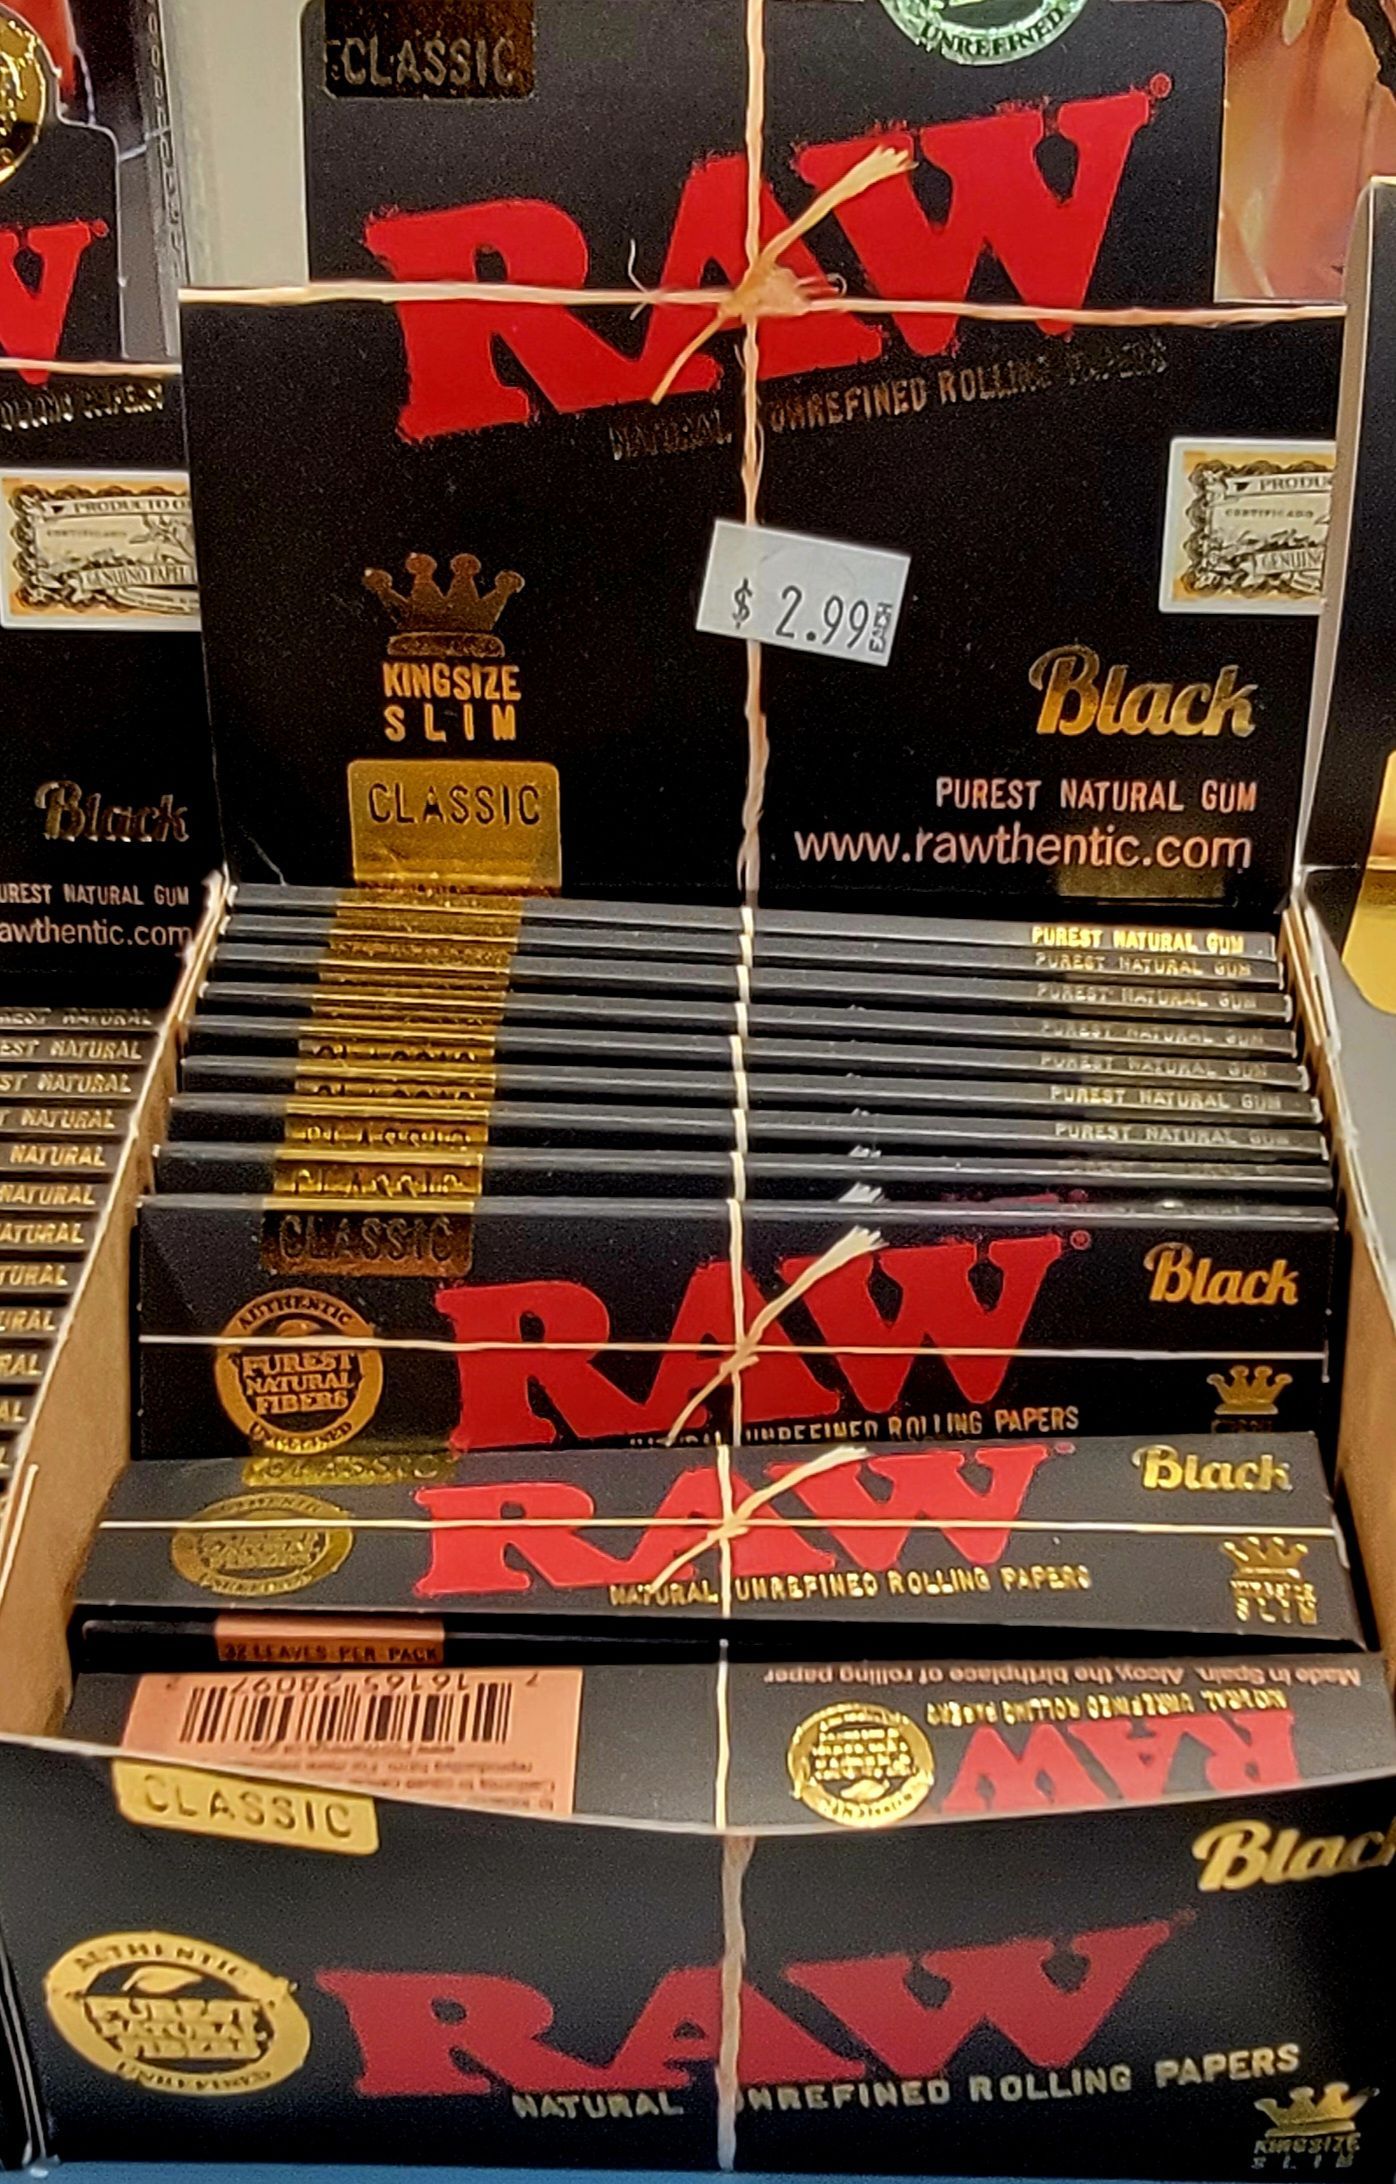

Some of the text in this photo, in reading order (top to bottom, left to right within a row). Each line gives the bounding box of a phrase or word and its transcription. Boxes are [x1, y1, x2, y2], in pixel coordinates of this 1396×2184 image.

[920, 7, 1066, 57] UNREFINED
[340, 36, 515, 87] CLASSIC
[363, 88, 1151, 442] RAW
[733, 577, 869, 650] $ 2.99
[382, 662, 521, 701] KINGSIZE
[1028, 644, 1259, 737] Black
[34, 779, 190, 842] Black
[367, 781, 542, 825] CLASSIC
[936, 776, 1258, 813] PUREST NATURAL GUM
[794, 821, 1253, 869] www.rawthentic.com
[62, 883, 144, 905] NATURAL
[154, 884, 190, 907] GUM
[1032, 926, 1102, 949] PUREST
[1113, 930, 1199, 954] NATURAL
[1035, 951, 1105, 971] PUREST
[1119, 956, 1204, 977] NATURAL
[51, 1039, 142, 1060] NATURAL
[38, 1073, 132, 1094] NATURAL
[1050, 1085, 1126, 1105] PUREST
[1139, 1090, 1230, 1111] NATURAL
[21, 1108, 116, 1130] NATURAL
[10, 1144, 106, 1167] NATURAL
[279, 1213, 453, 1263] CLASSIC
[1144, 1241, 1300, 1307] Black
[237, 1295, 353, 1331] AUTHENTIC
[434, 1232, 1064, 1452] RAW
[246, 1371, 356, 1396] NATURAL
[995, 1405, 1079, 1434] PAPERS
[1132, 1443, 1294, 1492] Black
[412, 1442, 1049, 1599] RAW
[609, 1564, 1093, 1606] NATURAL UNREFINED ROLLING PAPERS
[338, 1645, 377, 1662] PER
[388, 1646, 438, 1663] PACK
[764, 1663, 833, 1686] paper
[840, 1663, 913, 1686] rolling
[918, 1666, 943, 1685] of
[949, 1664, 1068, 1686] birthplace
[1074, 1665, 1112, 1685] the
[1296, 1667, 1361, 1687] Made
[939, 1704, 1298, 1818] RAW
[143, 1773, 354, 1839] CLASSIC
[314, 1918, 1171, 2098] RAW
[512, 2091, 685, 2120] NATURAL
[969, 2065, 1133, 2102] ROLLING
[1155, 2042, 1300, 2090] PAPERS
